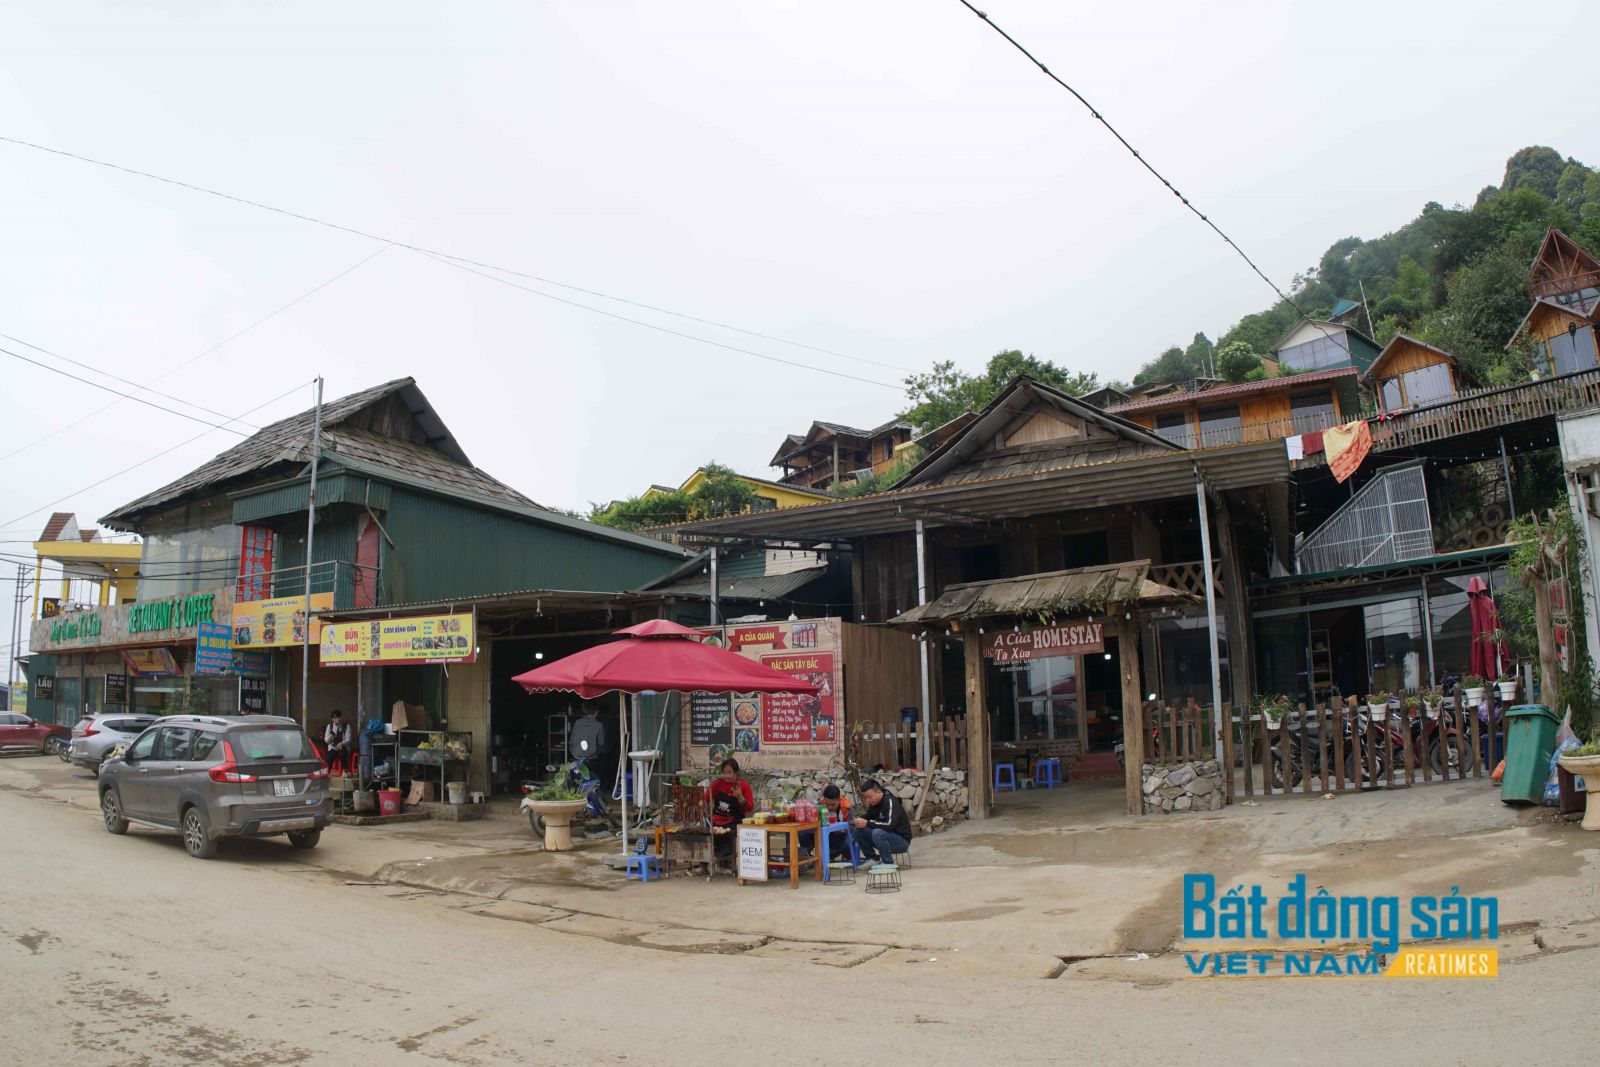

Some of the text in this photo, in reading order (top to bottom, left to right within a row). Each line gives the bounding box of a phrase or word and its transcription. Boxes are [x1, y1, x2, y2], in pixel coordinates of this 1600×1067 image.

[128, 593, 215, 635] RESTAURANT & COFFEE
[344, 627, 359, 641] BÚN
[740, 634, 745, 642] A
[994, 634, 1004, 647] A
[1032, 623, 1102, 649] HOMESTAY
[344, 642, 359, 654] PHỞ
[995, 648, 1008, 660] Tà
[1011, 647, 1031, 660] Xùa
[807, 657, 819, 669] BẮC
[38, 676, 52, 688] LẨU
[741, 847, 763, 857] KEM
